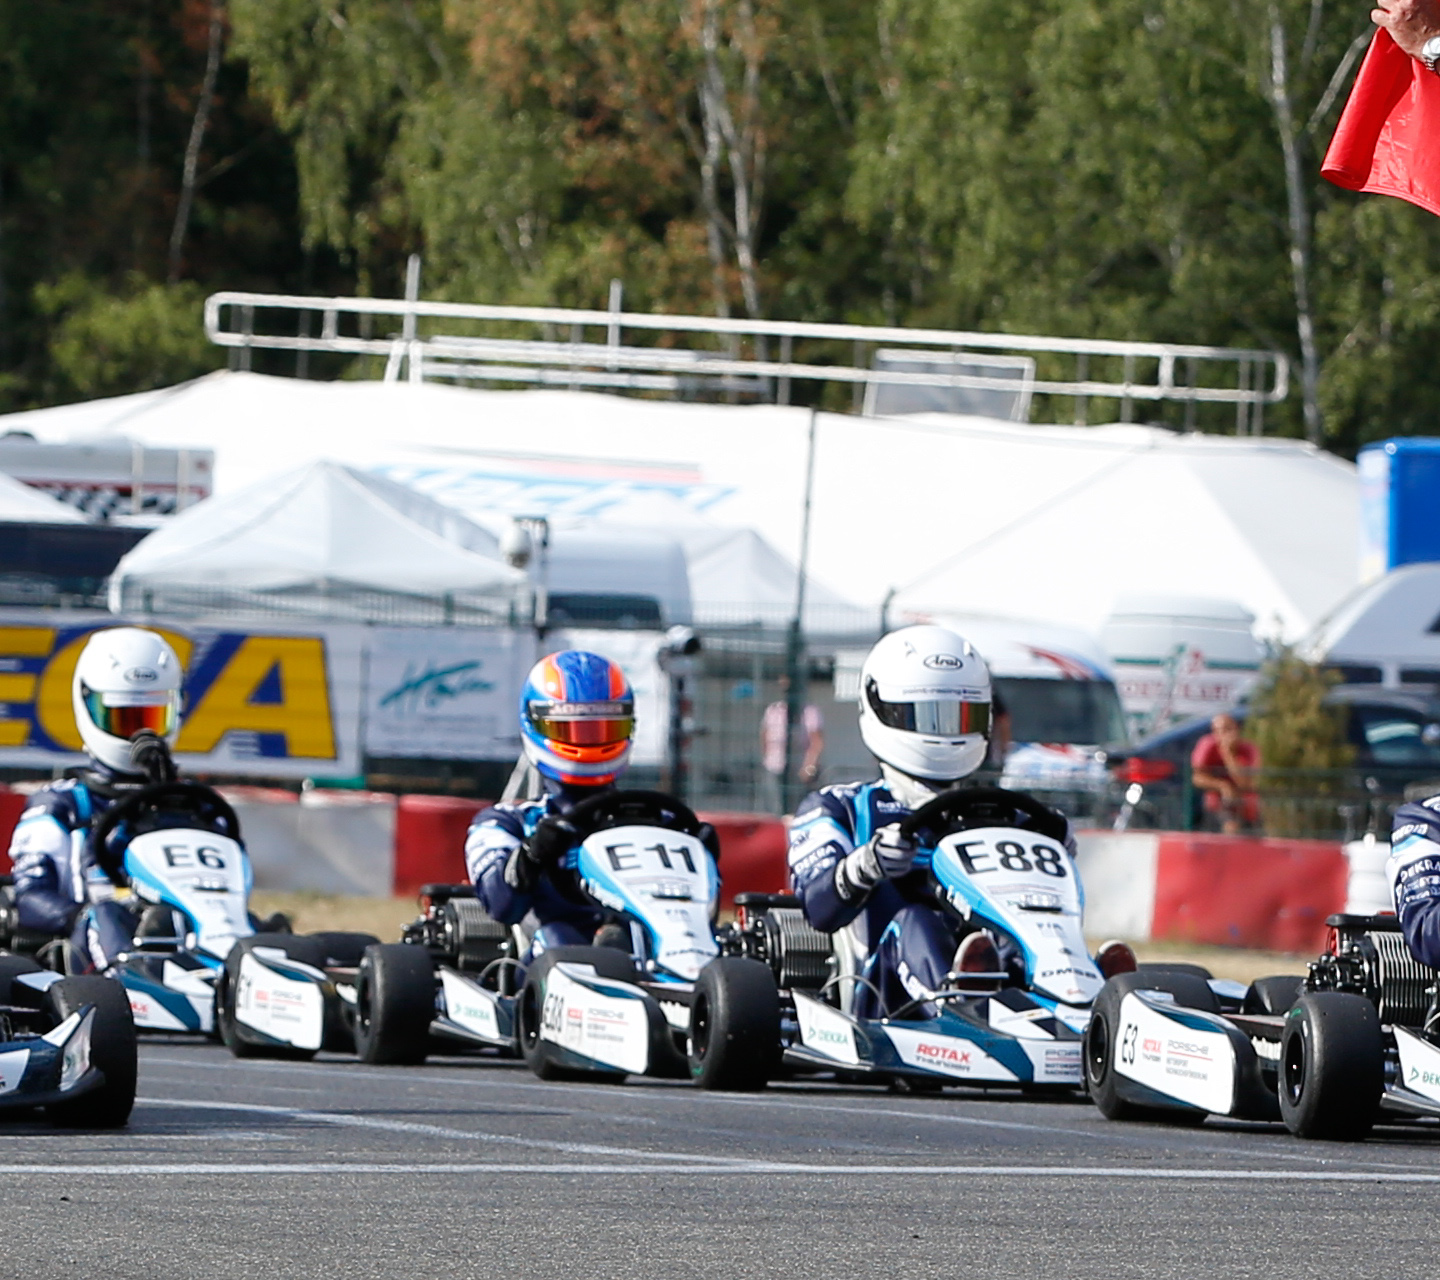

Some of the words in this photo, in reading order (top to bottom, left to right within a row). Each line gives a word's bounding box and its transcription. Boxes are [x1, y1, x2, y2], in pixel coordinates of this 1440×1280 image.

[931, 655, 959, 666] Arai
[161, 844, 226, 870] E6
[605, 843, 697, 874] E11
[954, 840, 1068, 878] E88
[1041, 967, 1097, 979] DMSB
[916, 1043, 971, 1064] ROTAX
[1122, 1022, 1138, 1065] E3
